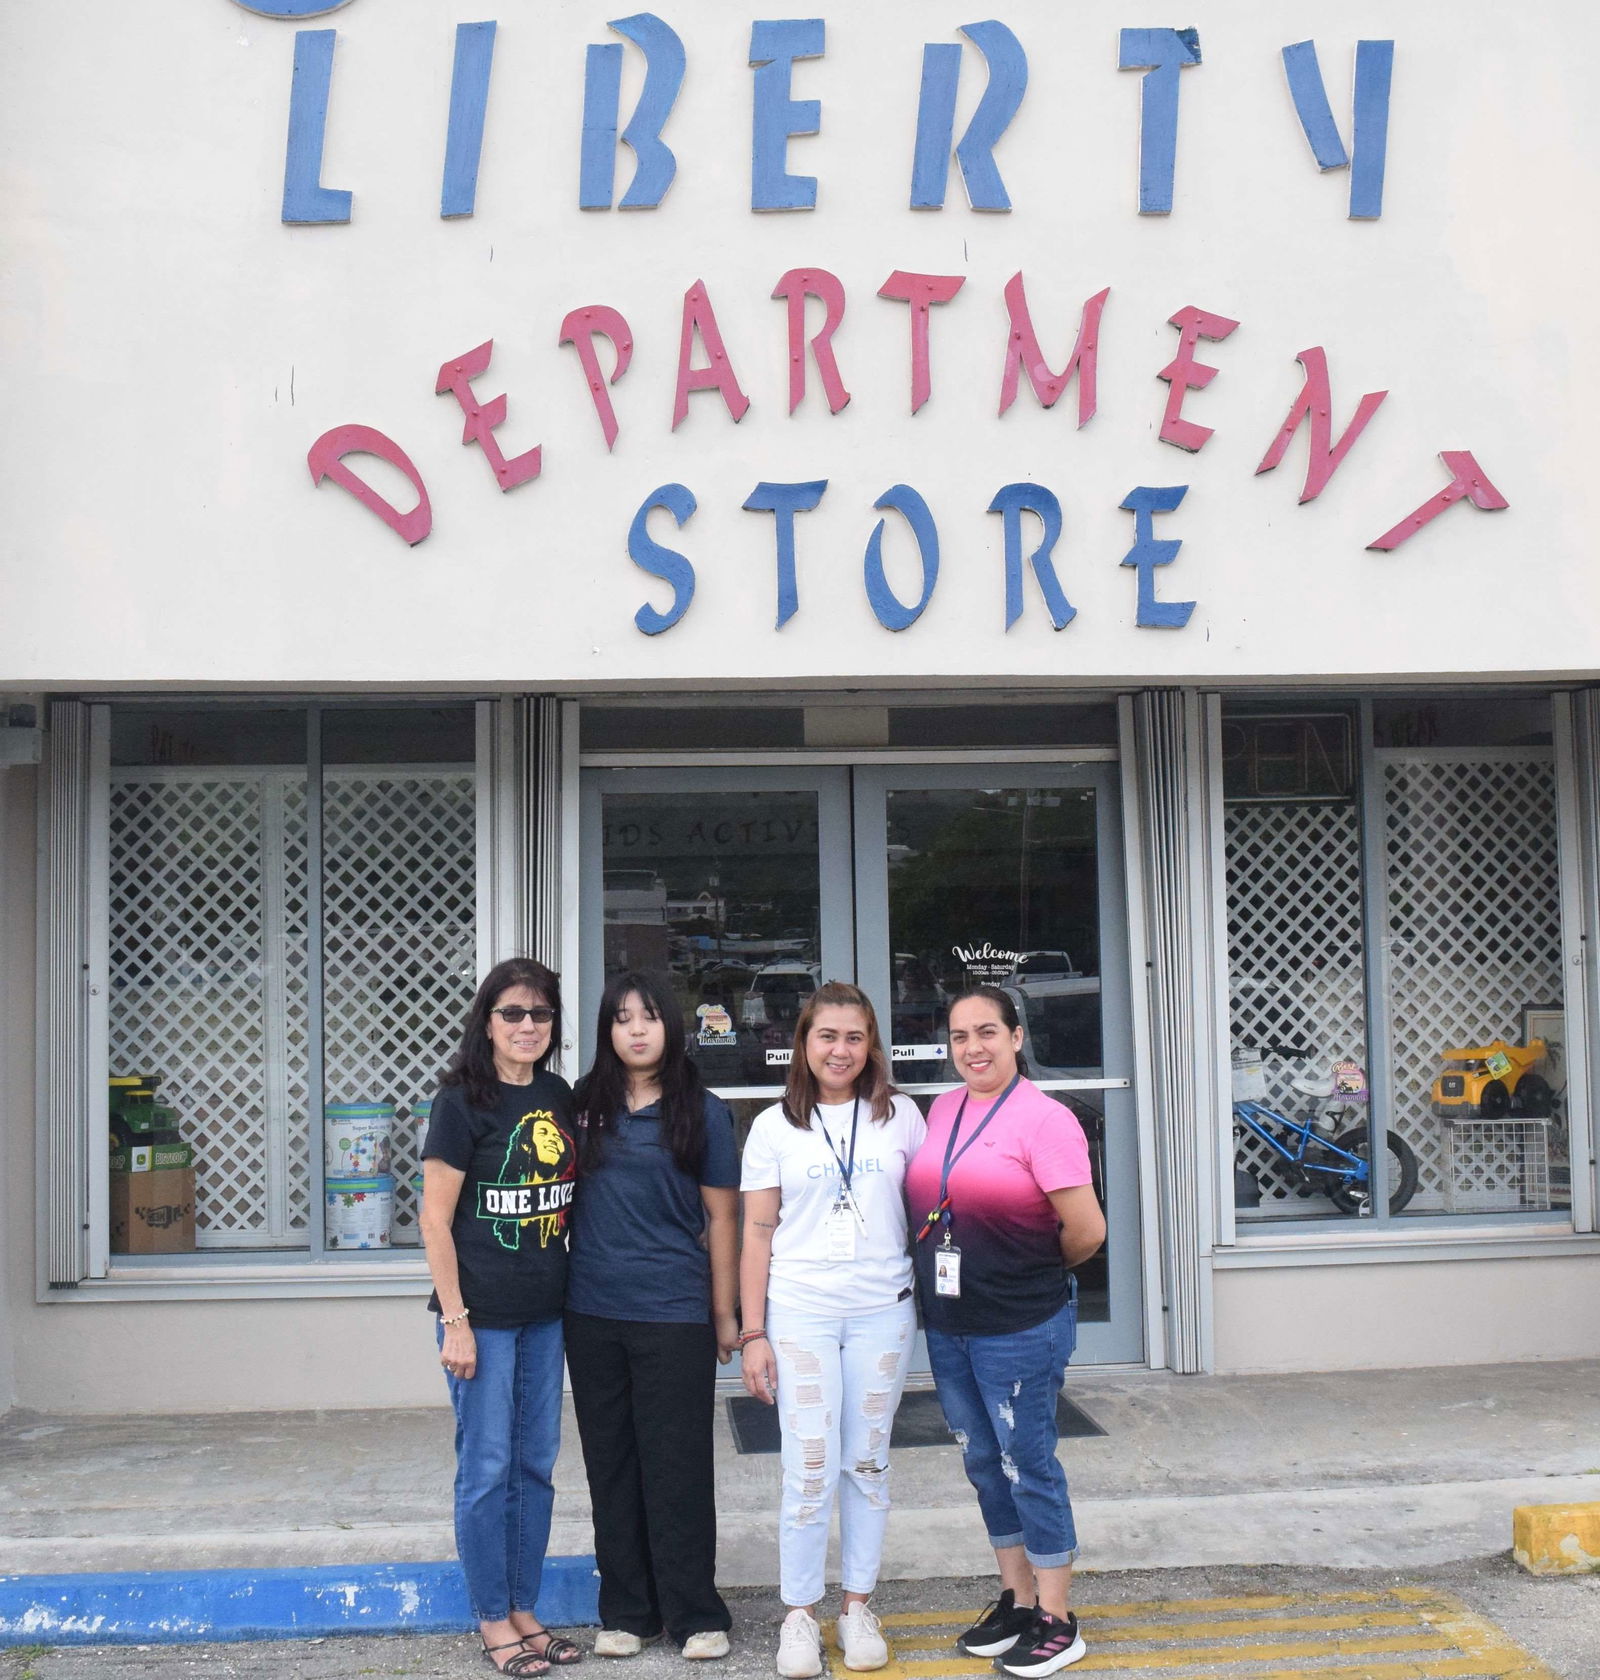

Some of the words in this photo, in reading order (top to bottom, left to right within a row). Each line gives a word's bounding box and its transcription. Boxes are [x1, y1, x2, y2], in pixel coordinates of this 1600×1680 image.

[281, 12, 1394, 225] LIBERTY
[307, 267, 1510, 553] DEPARTMENT
[628, 479, 1197, 636] STORE
[952, 942, 1029, 964] Welcome
[767, 1053, 790, 1061] Pull
[892, 1049, 914, 1057] Pull
[807, 1158, 884, 1179] CHNEL
[486, 1189, 532, 1214] ONE
[537, 1182, 575, 1211] LOVE
